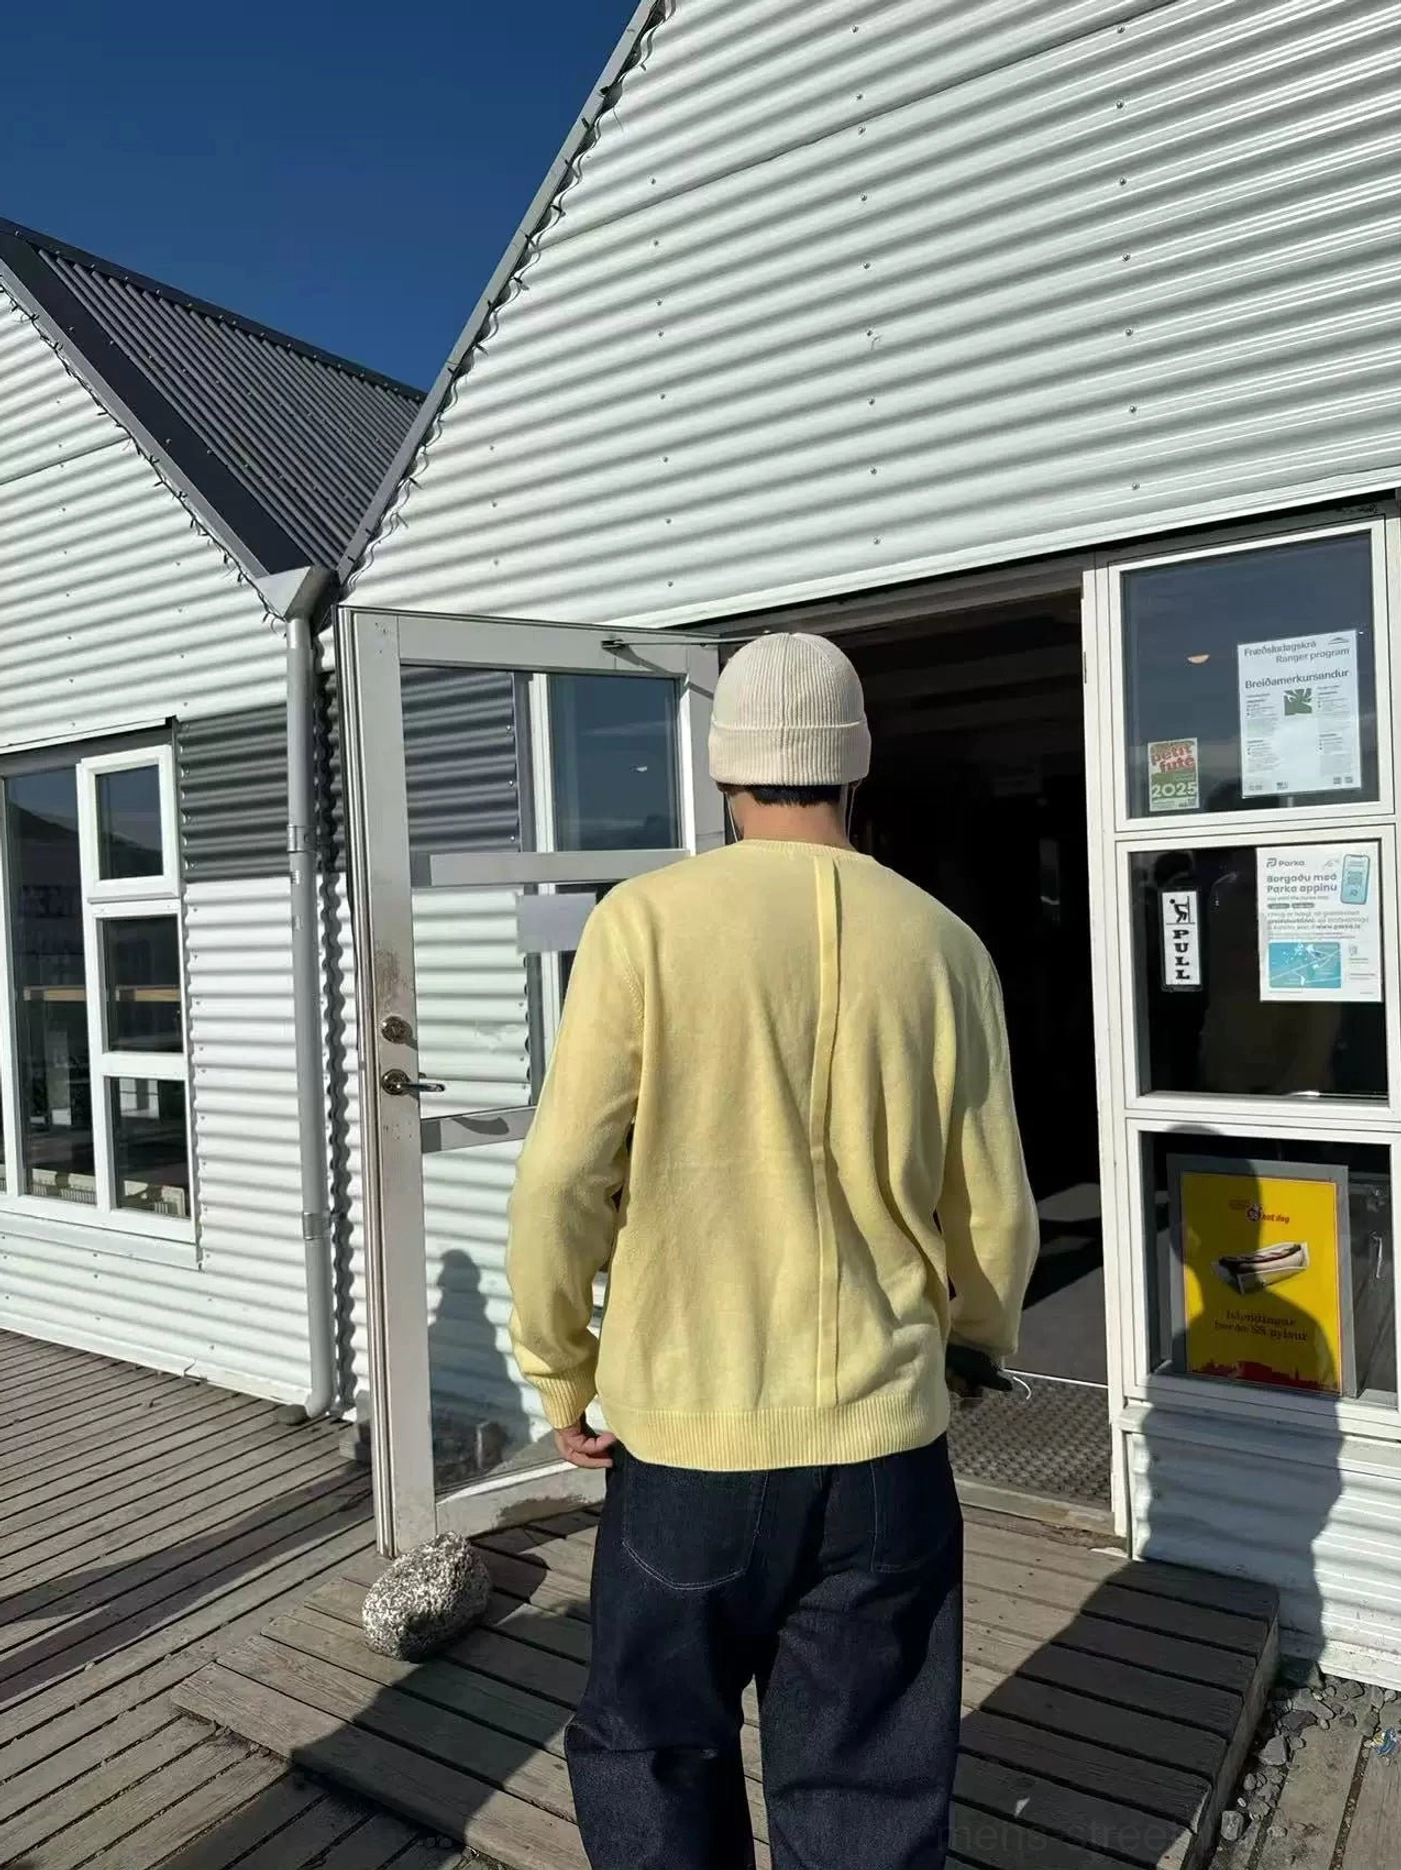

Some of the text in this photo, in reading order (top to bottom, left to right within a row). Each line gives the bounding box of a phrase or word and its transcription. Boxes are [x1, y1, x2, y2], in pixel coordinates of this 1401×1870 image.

[1276, 647, 1350, 663] Ranger program
[1245, 669, 1349, 689] Breiðamerkursandur
[1152, 781, 1197, 798] 2025
[1278, 859, 1305, 868] Parka
[1267, 884, 1297, 893] Parka
[1172, 929, 1190, 980] PULL
